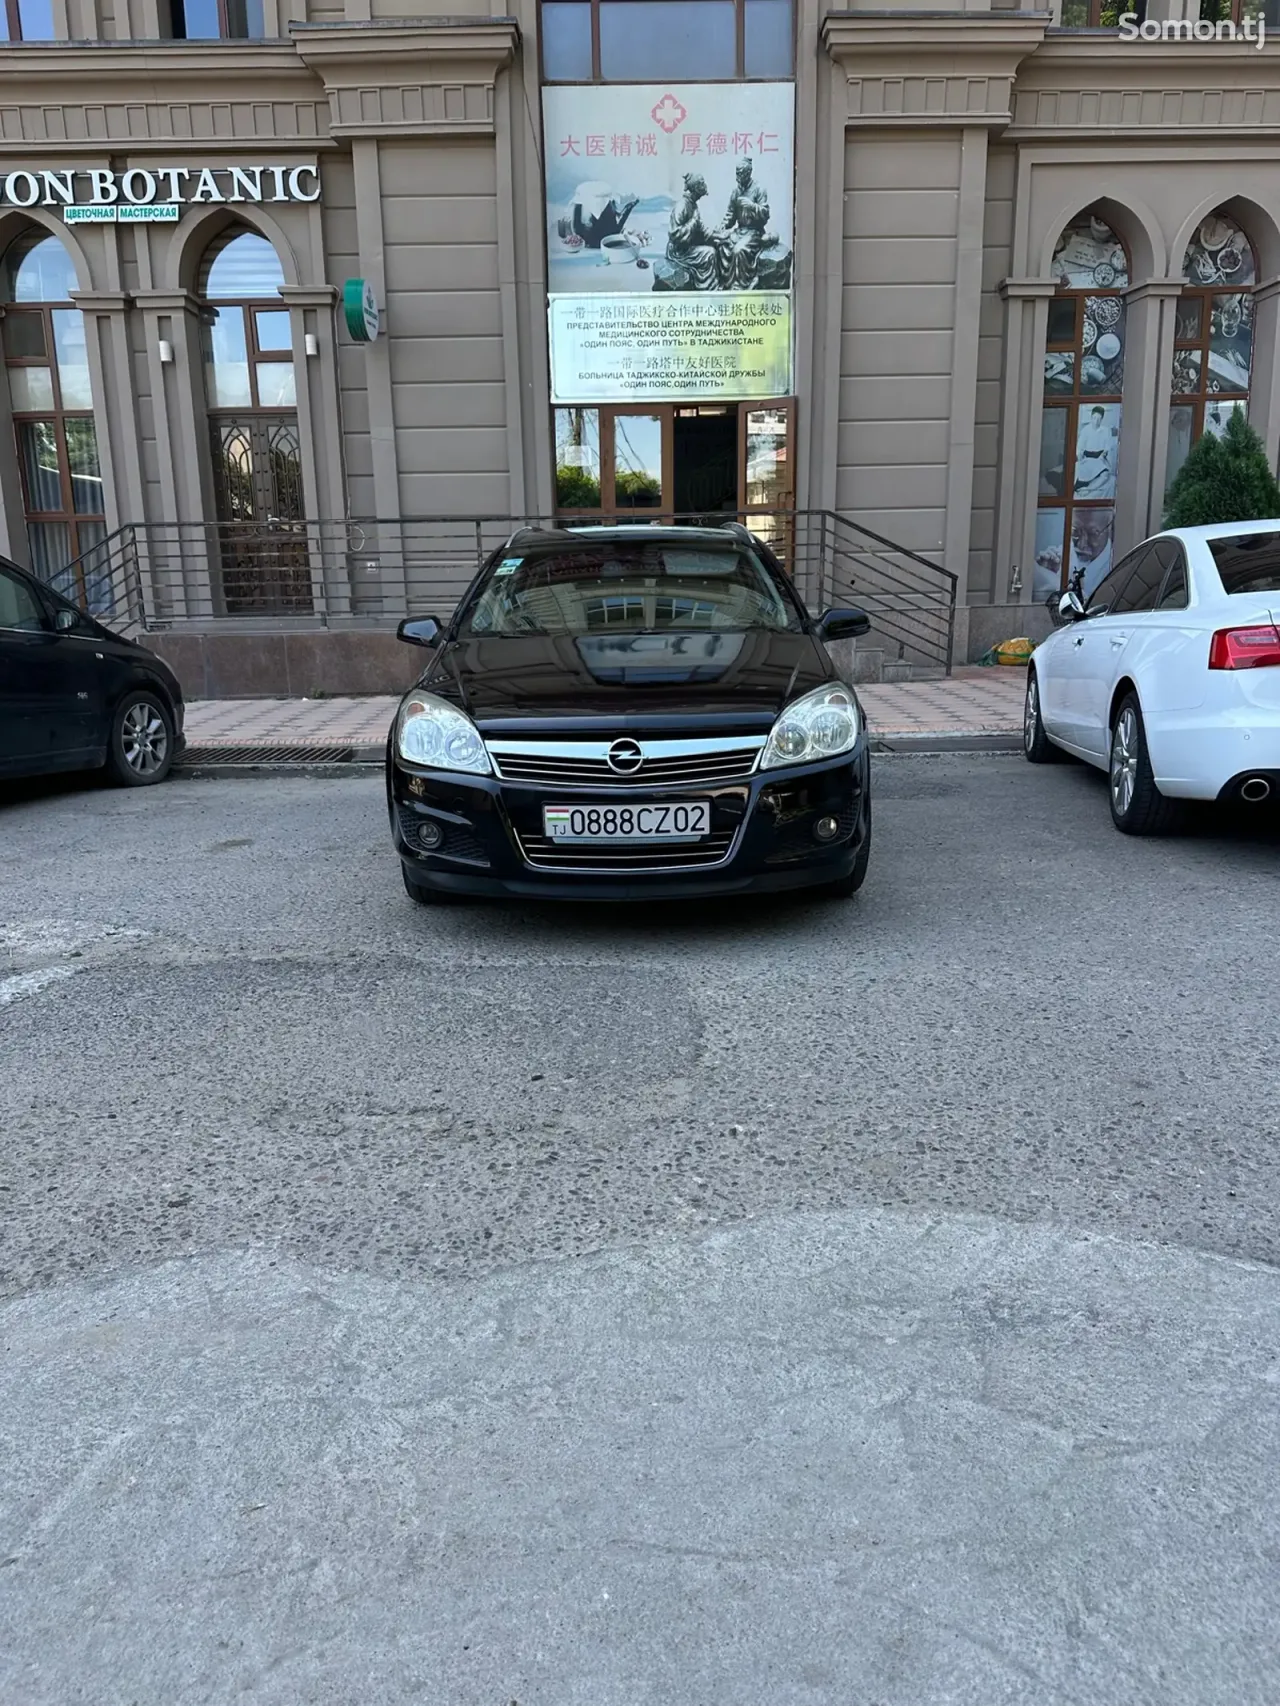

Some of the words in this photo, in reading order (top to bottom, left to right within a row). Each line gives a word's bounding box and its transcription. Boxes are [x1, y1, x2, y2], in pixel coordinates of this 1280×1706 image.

[560, 134, 658, 157] 大医精诚
[681, 131, 779, 155] 厚德怀仁
[3, 170, 75, 206] ON
[86, 165, 321, 204] BOTANIC
[66, 208, 115, 219] ЦВЕТОЧНАЯ
[120, 207, 177, 217] МАСТЕРСКАЯ
[567, 321, 660, 330] ПРЕДСТАВИТЕЛЬСТВО
[661, 320, 694, 329] ЦЕНТРА
[695, 318, 776, 328] МЕЖДУНАРОДНОГО
[599, 330, 667, 339] МЕДИЦИНСКОГО
[669, 329, 744, 338] СОТРУДНИЧЕСТВА
[637, 340, 660, 348] ОДИН
[699, 337, 764, 346] ТАДЖИКИСТАНЕ
[578, 372, 624, 381] БОЛЬНИЦА
[728, 370, 766, 378] ДРУЖБЫ
[570, 805, 705, 836] 0888CZ02
[552, 824, 567, 836] TJ
